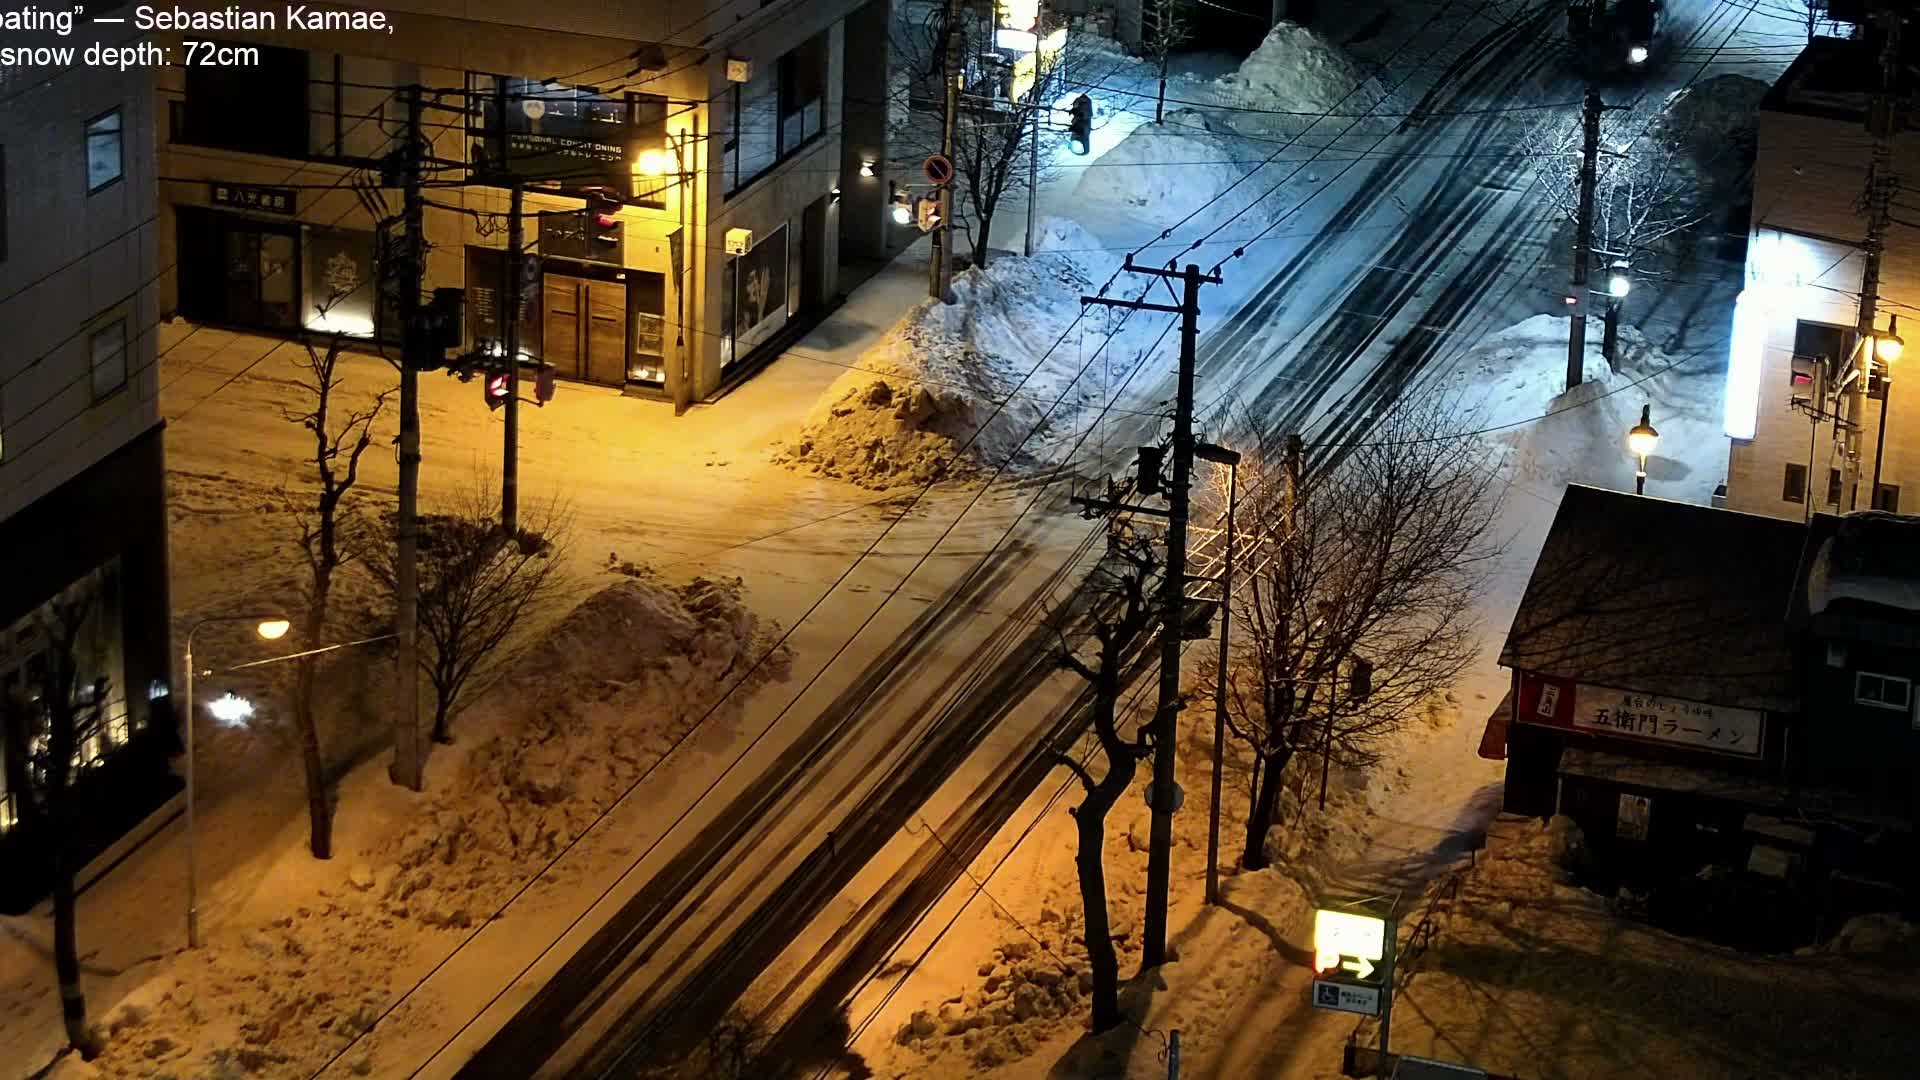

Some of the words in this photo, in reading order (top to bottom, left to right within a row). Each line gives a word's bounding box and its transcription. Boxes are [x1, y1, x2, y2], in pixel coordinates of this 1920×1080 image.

[1591, 708, 1745, 746] 五衛門ラーメン
